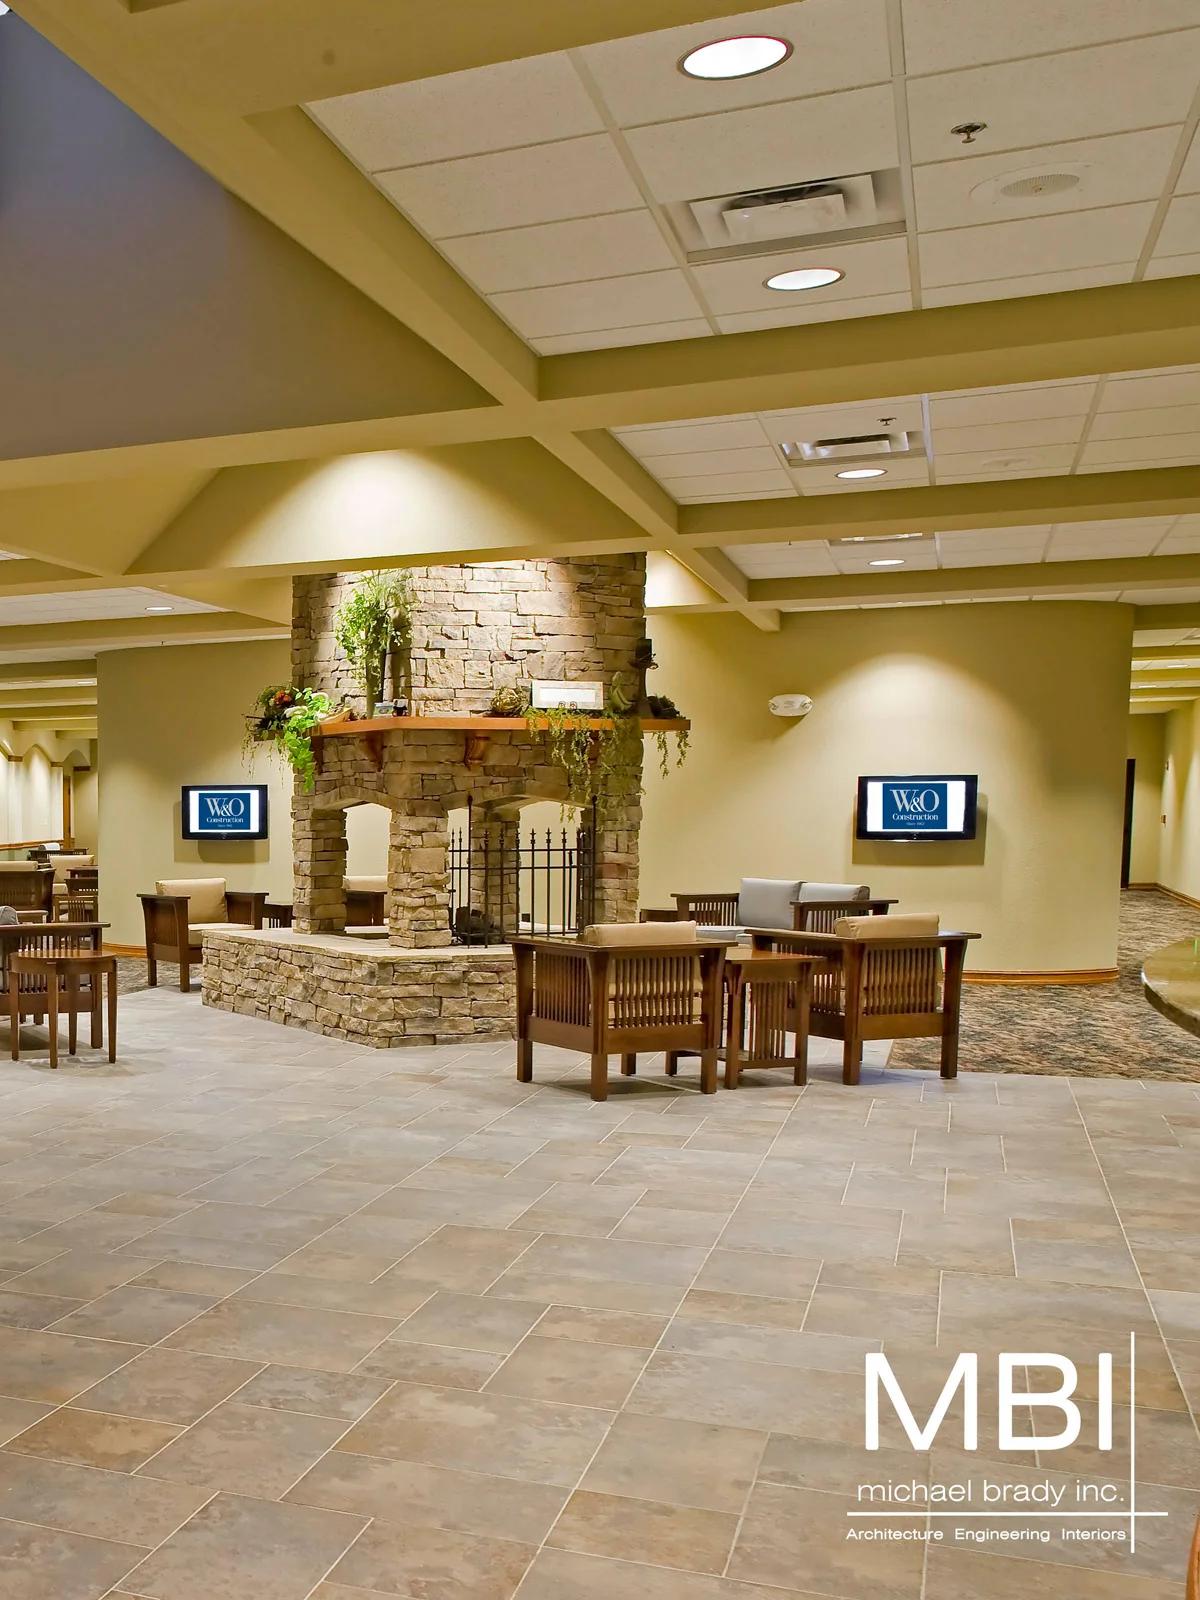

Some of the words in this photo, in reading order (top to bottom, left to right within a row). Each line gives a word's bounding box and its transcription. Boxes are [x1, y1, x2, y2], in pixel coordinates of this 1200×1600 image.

[204, 797, 245, 817] W&O
[889, 789, 940, 812] W&O
[892, 813, 939, 821] Construction
